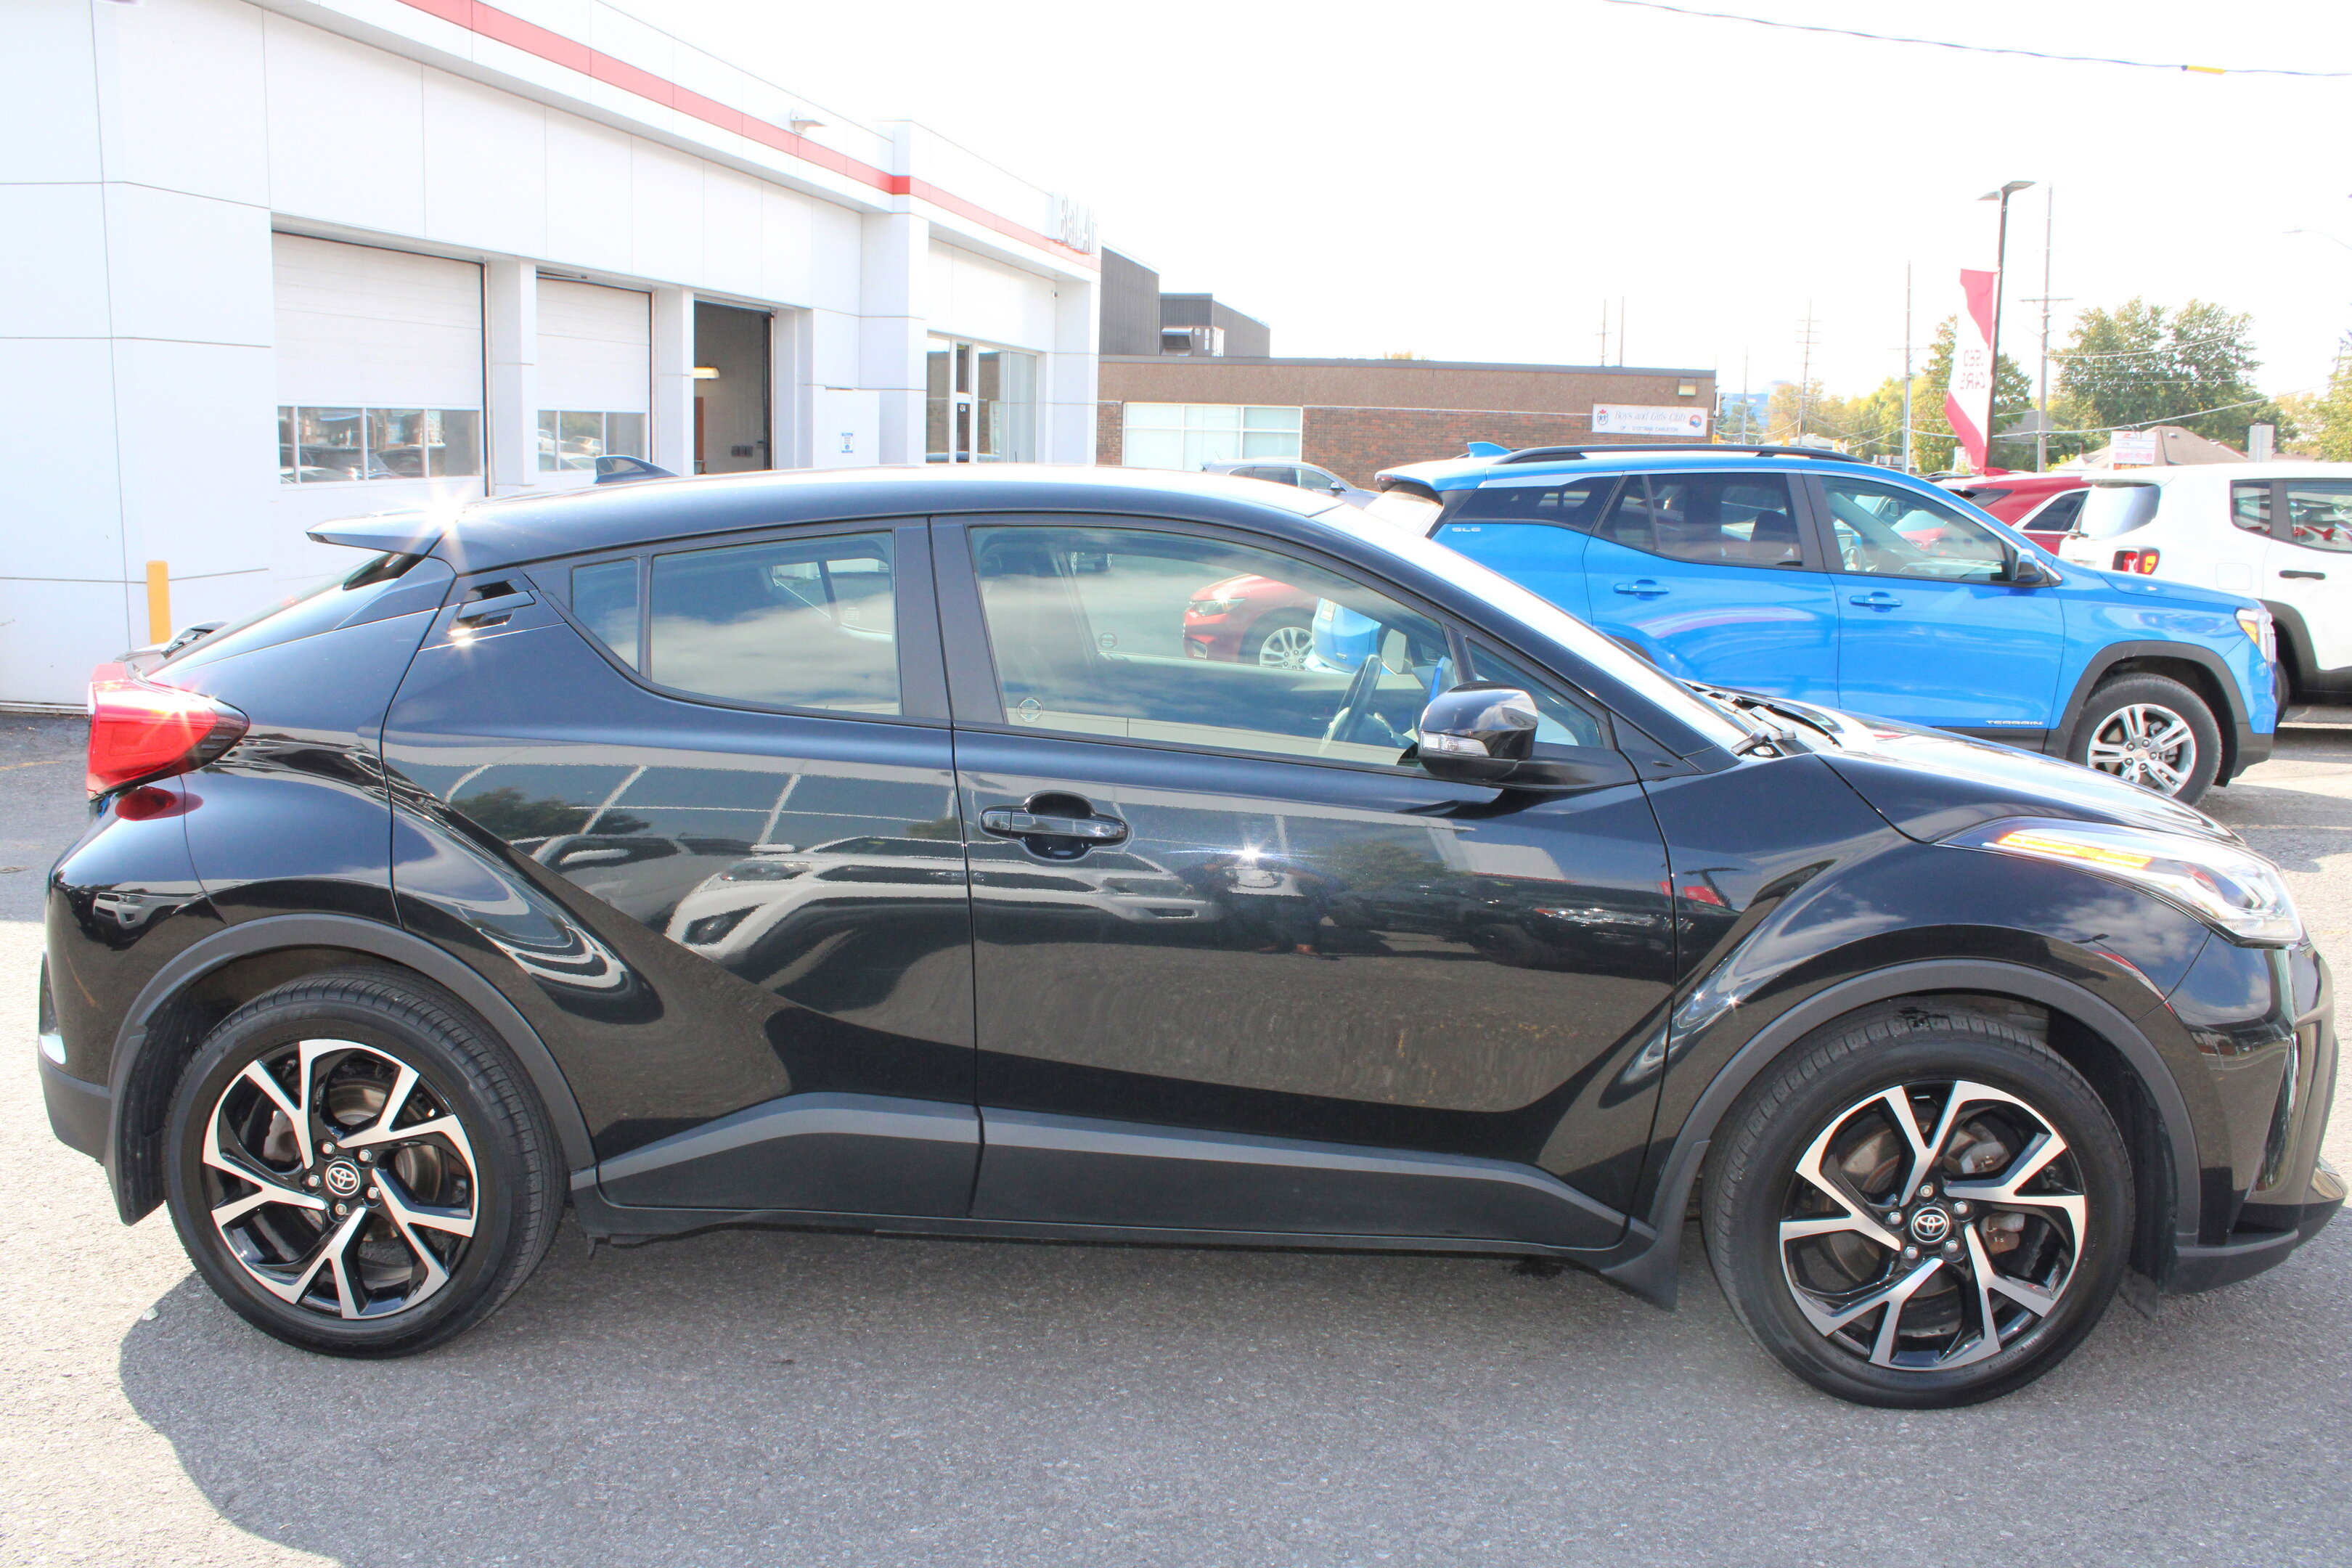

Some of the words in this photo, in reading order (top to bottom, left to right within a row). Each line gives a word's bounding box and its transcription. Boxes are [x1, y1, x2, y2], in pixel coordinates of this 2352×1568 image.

[1614, 411, 1632, 421] Boys
[1634, 412, 1649, 420] and
[1651, 412, 1667, 421] Girls
[1669, 412, 1686, 422] Club
